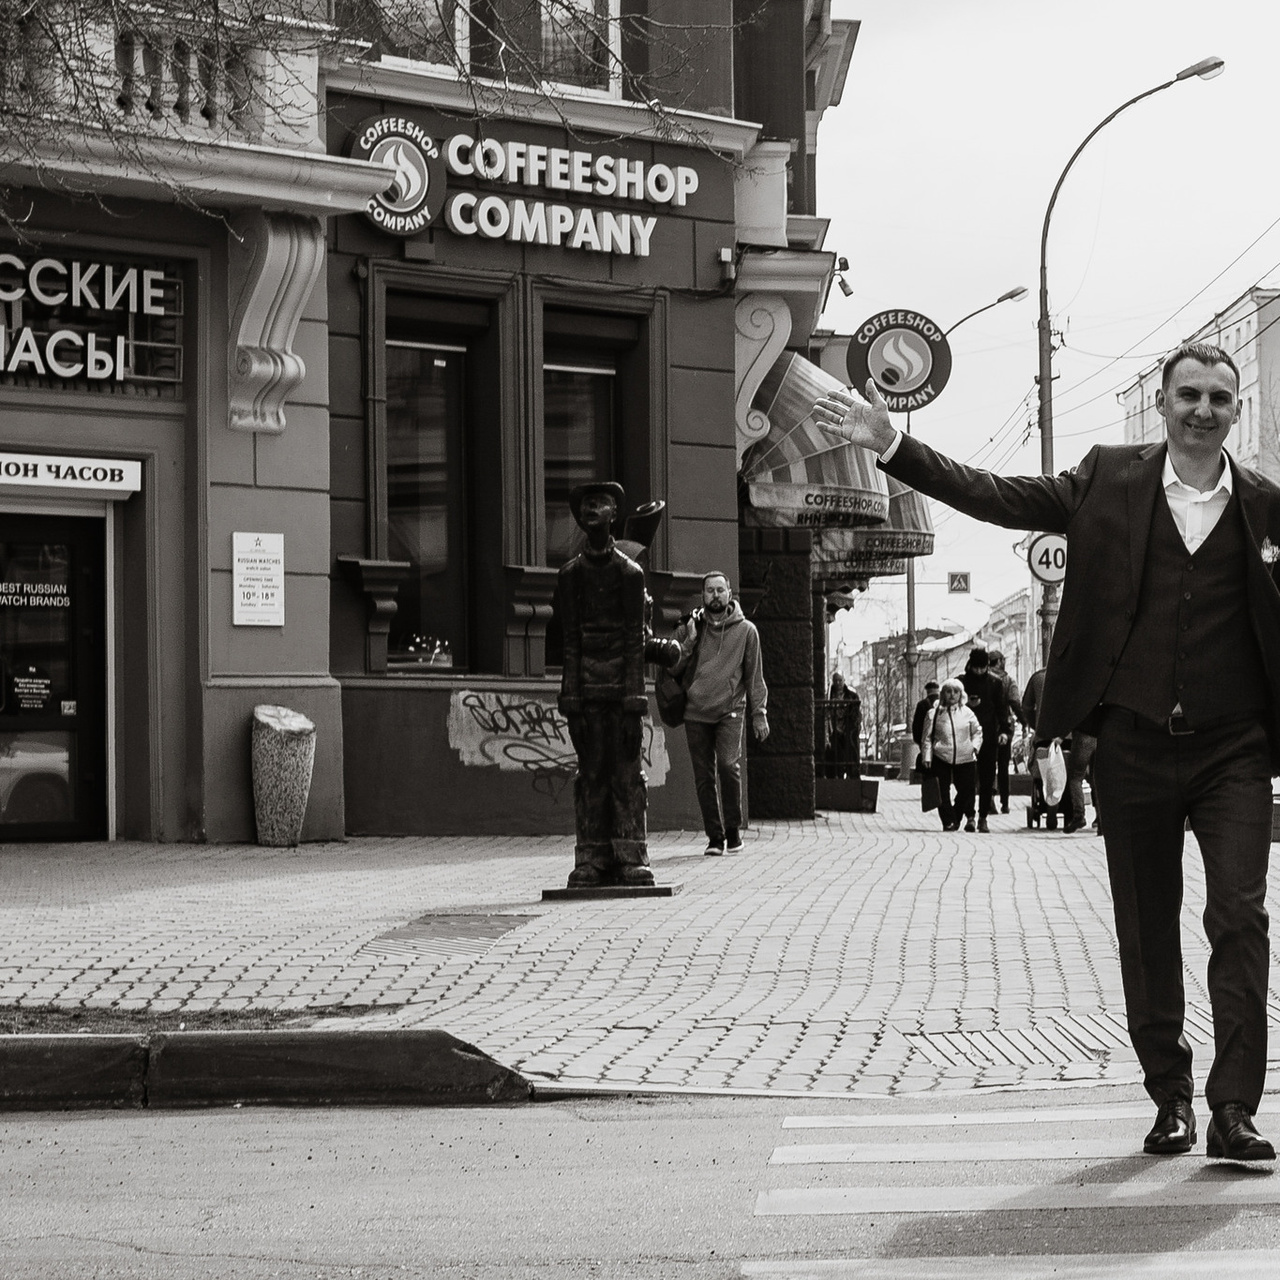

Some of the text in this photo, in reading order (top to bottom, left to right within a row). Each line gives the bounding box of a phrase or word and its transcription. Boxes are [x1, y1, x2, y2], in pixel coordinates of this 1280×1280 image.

[360, 118, 438, 159] COFFEESHOP
[443, 133, 698, 206] COFFEESHOP
[445, 192, 657, 256] COMPANY
[857, 312, 942, 344] COFFEESHOP
[0, 324, 125, 381] АСЫ
[0, 461, 125, 482] ОН ЧАСОВ
[804, 492, 873, 511] COFFEESHOP
[1038, 547, 1066, 569] 40
[0, 595, 71, 607] ATCH BRANDS
[23, 583, 67, 595] RUSSIAN
